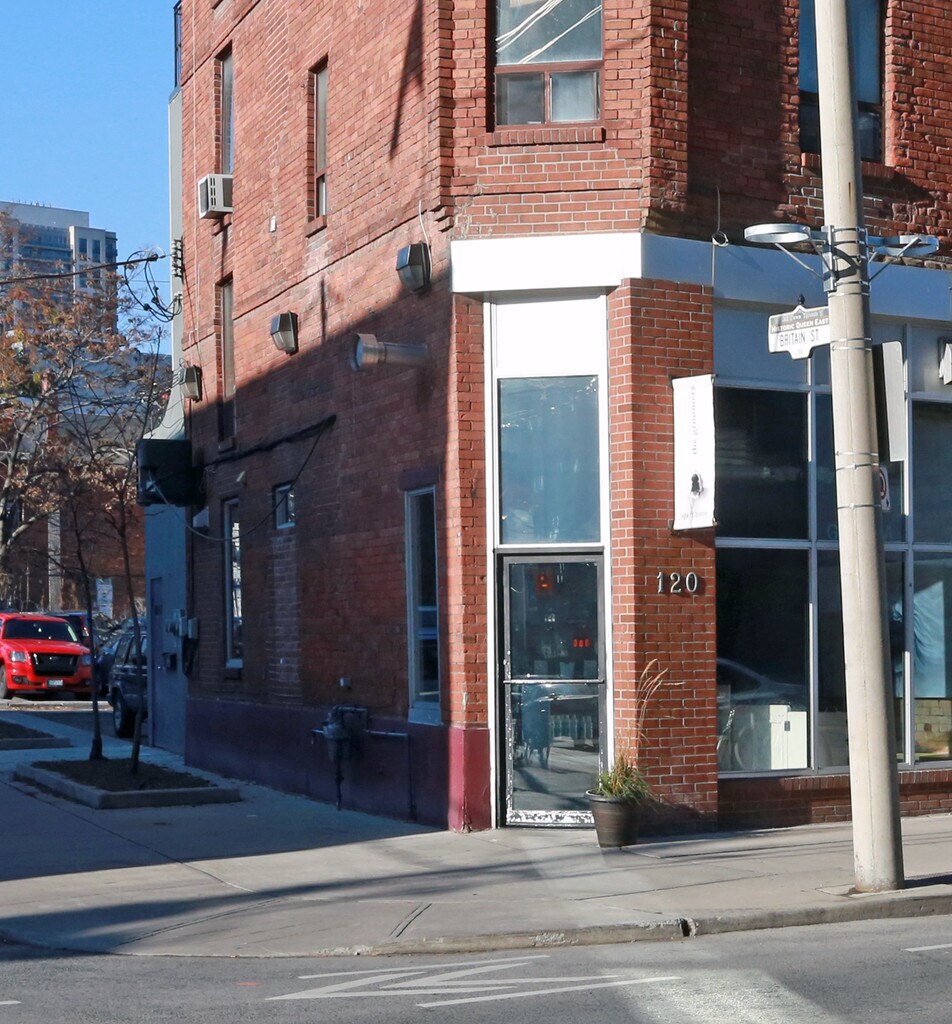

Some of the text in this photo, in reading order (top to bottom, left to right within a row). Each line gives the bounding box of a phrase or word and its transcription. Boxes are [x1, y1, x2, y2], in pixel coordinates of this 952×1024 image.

[815, 317, 829, 326] EAST
[780, 329, 819, 347] BRITAIN ST
[657, 571, 698, 594] 120
